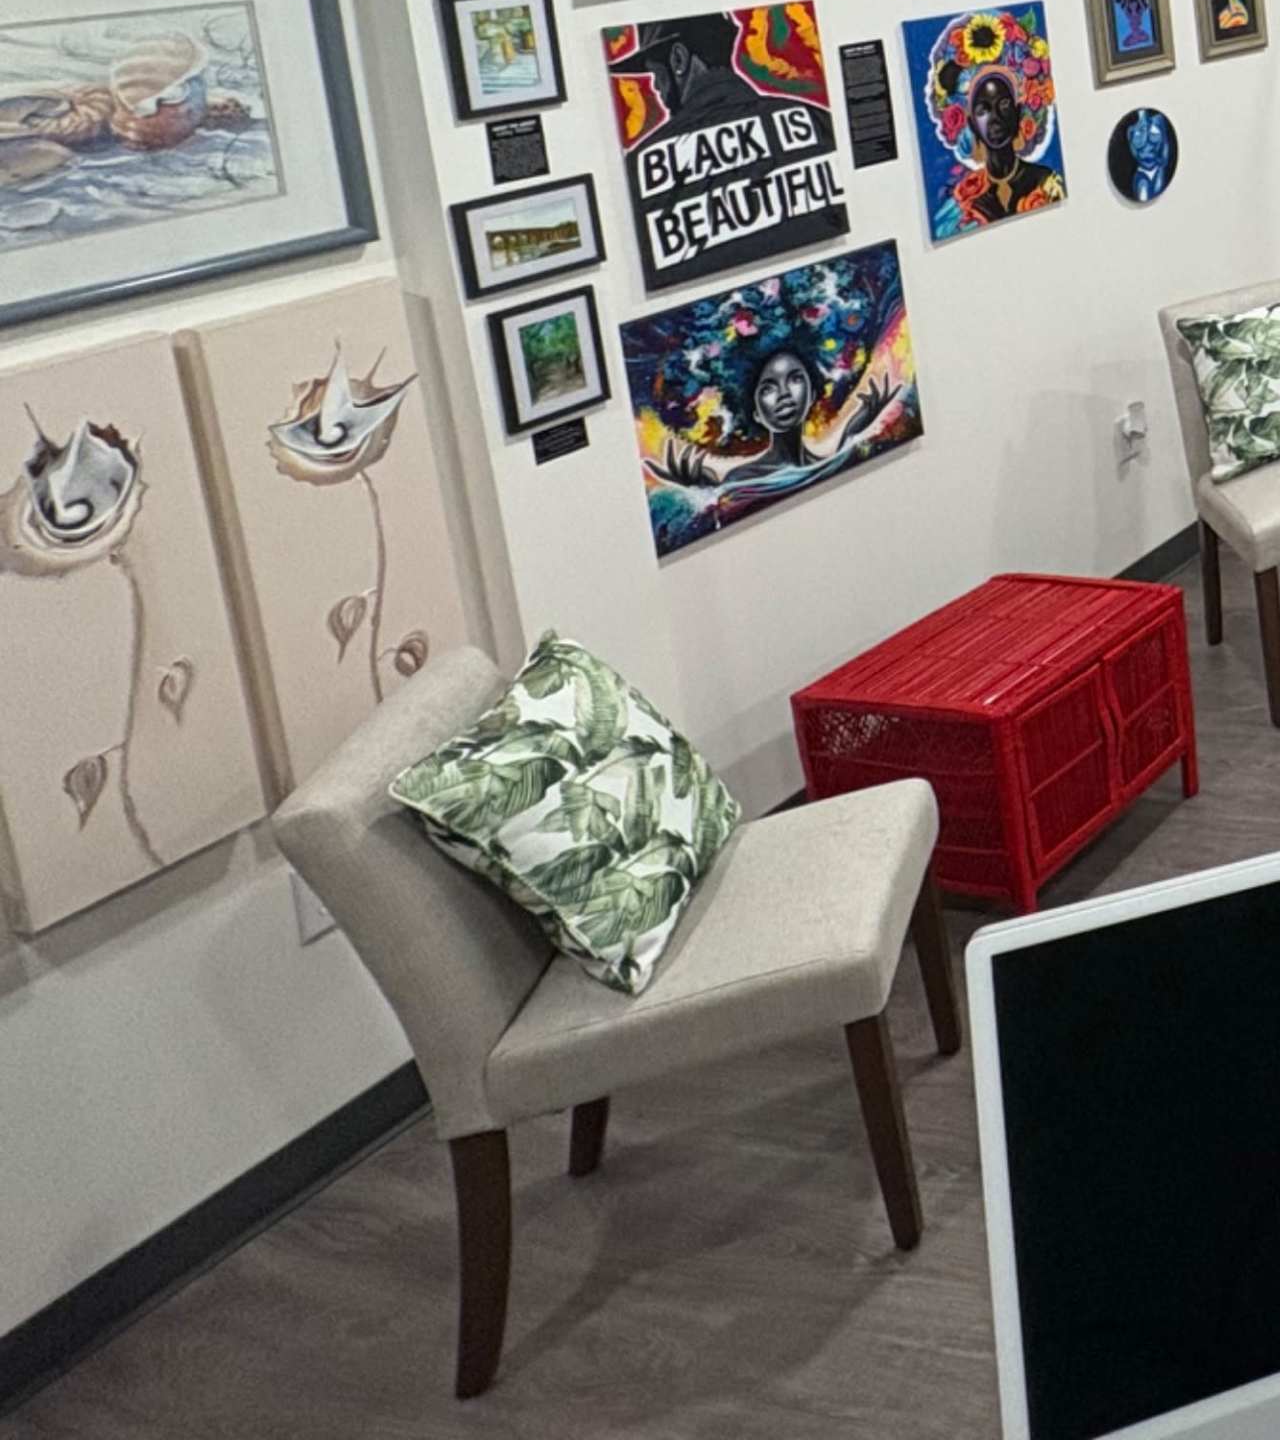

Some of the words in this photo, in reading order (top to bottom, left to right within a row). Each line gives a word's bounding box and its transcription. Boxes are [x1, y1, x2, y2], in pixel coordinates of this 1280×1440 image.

[643, 120, 768, 192] BLACK
[779, 110, 812, 144] IS
[654, 160, 845, 258] BEAUTIFUL
